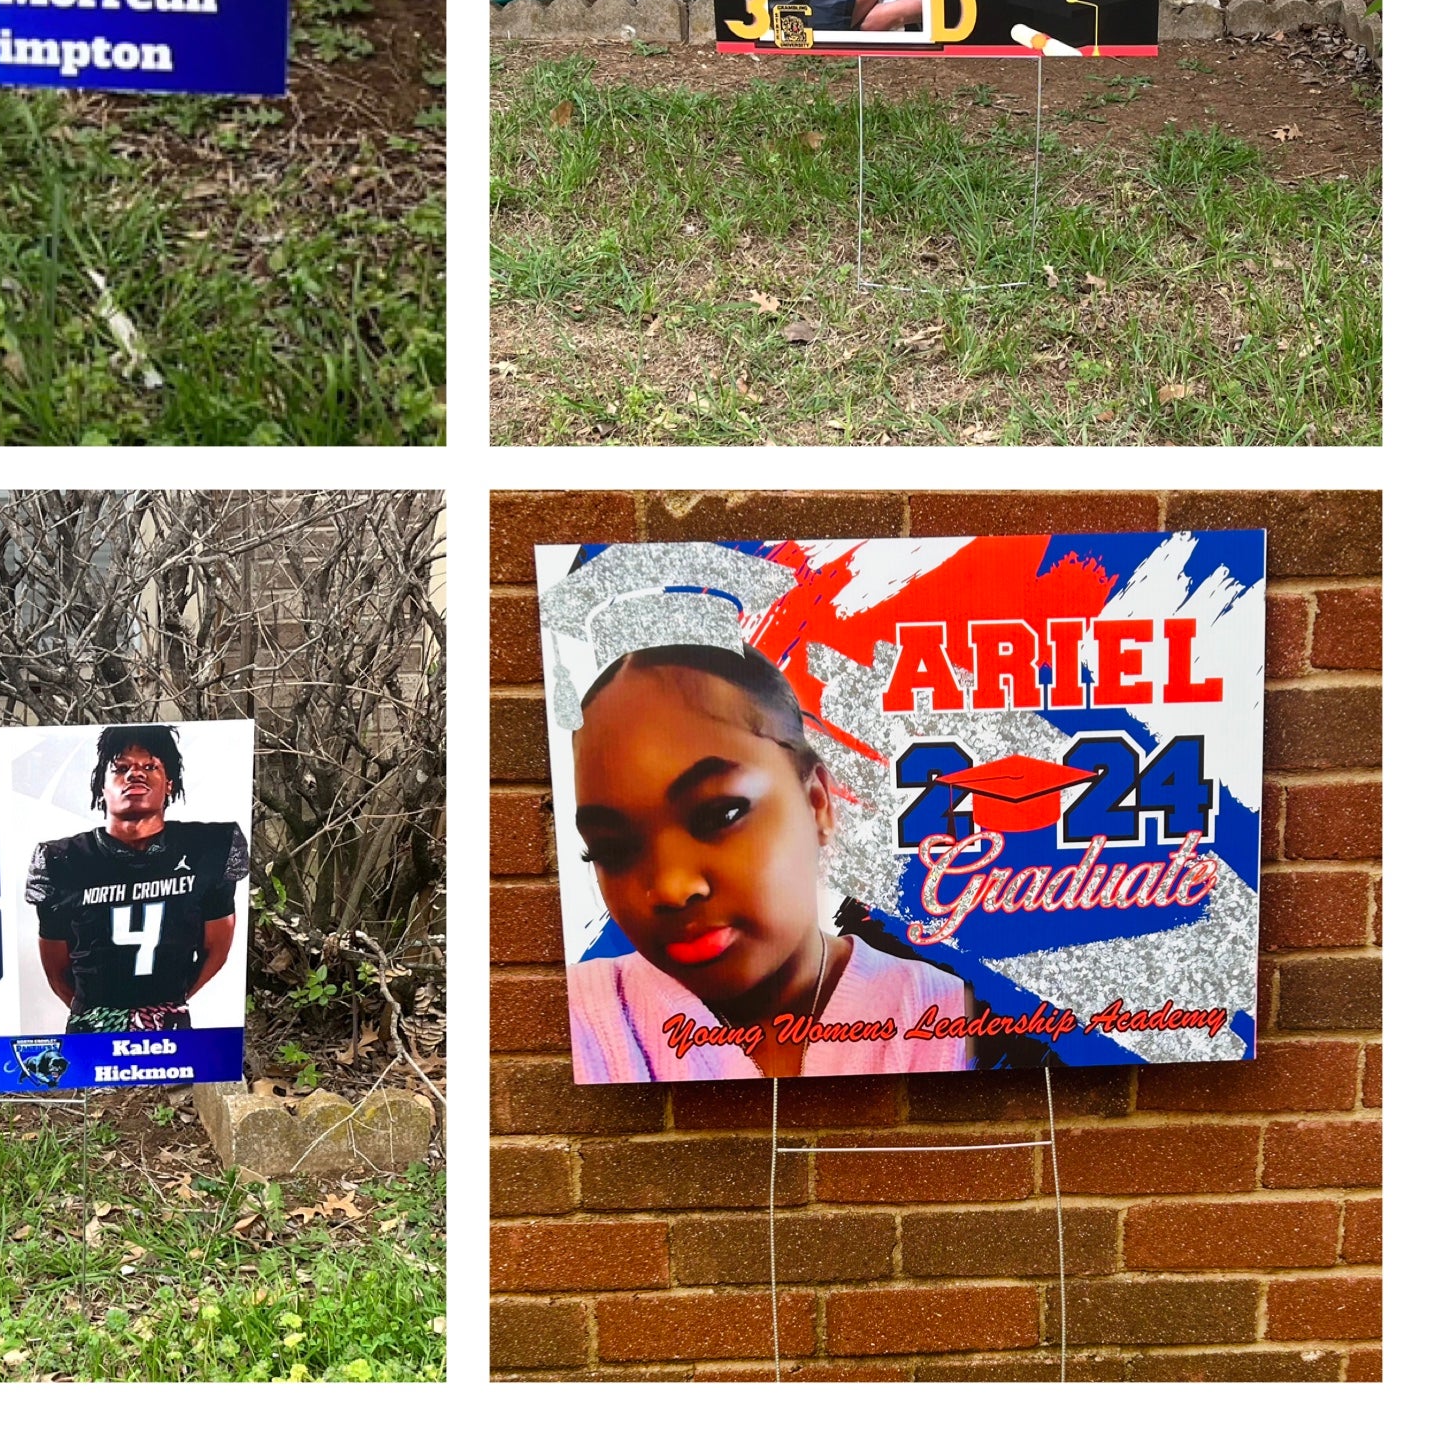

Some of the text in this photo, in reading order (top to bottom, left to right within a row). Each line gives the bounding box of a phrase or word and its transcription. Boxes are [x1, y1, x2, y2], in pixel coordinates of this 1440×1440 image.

[882, 617, 1224, 712] ARIEL
[83, 875, 195, 905] NORTH CROWLEY
[906, 830, 1220, 946] Graduate
[111, 901, 165, 976] 4
[112, 1039, 177, 1057] Kaleb
[662, 997, 1229, 1060] Young Womens Leadership Academy
[94, 1064, 194, 1083] Hickmon
